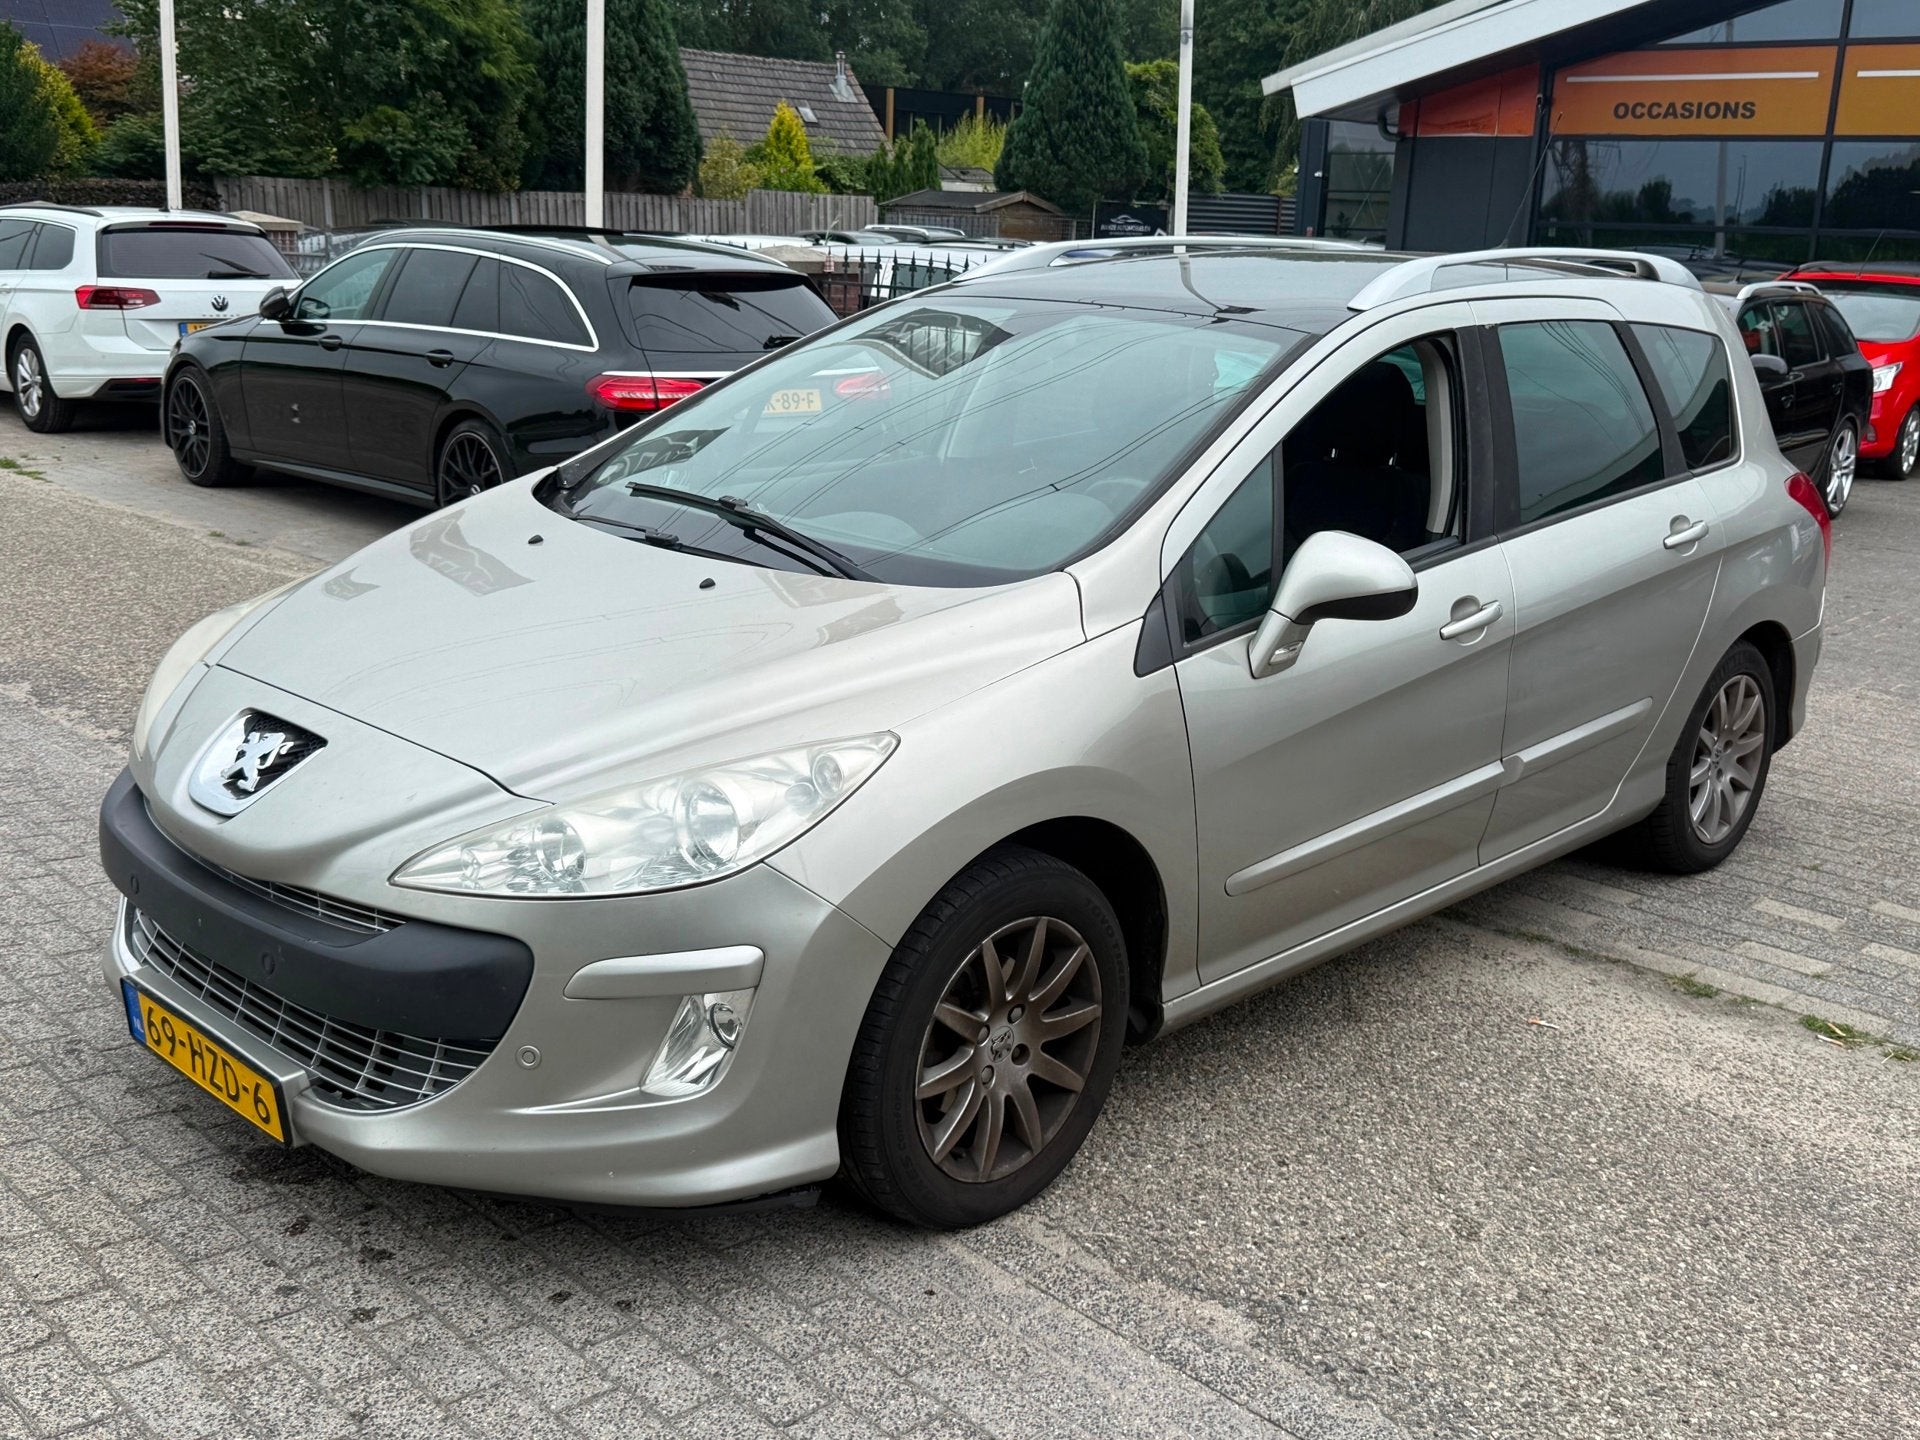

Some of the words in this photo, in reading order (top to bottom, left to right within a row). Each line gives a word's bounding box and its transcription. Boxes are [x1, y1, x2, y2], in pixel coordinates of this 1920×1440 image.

[1613, 101, 1756, 120] OCCASIONS
[133, 1017, 145, 1034] NL
[146, 1006, 271, 1125] 69-HZD-6
